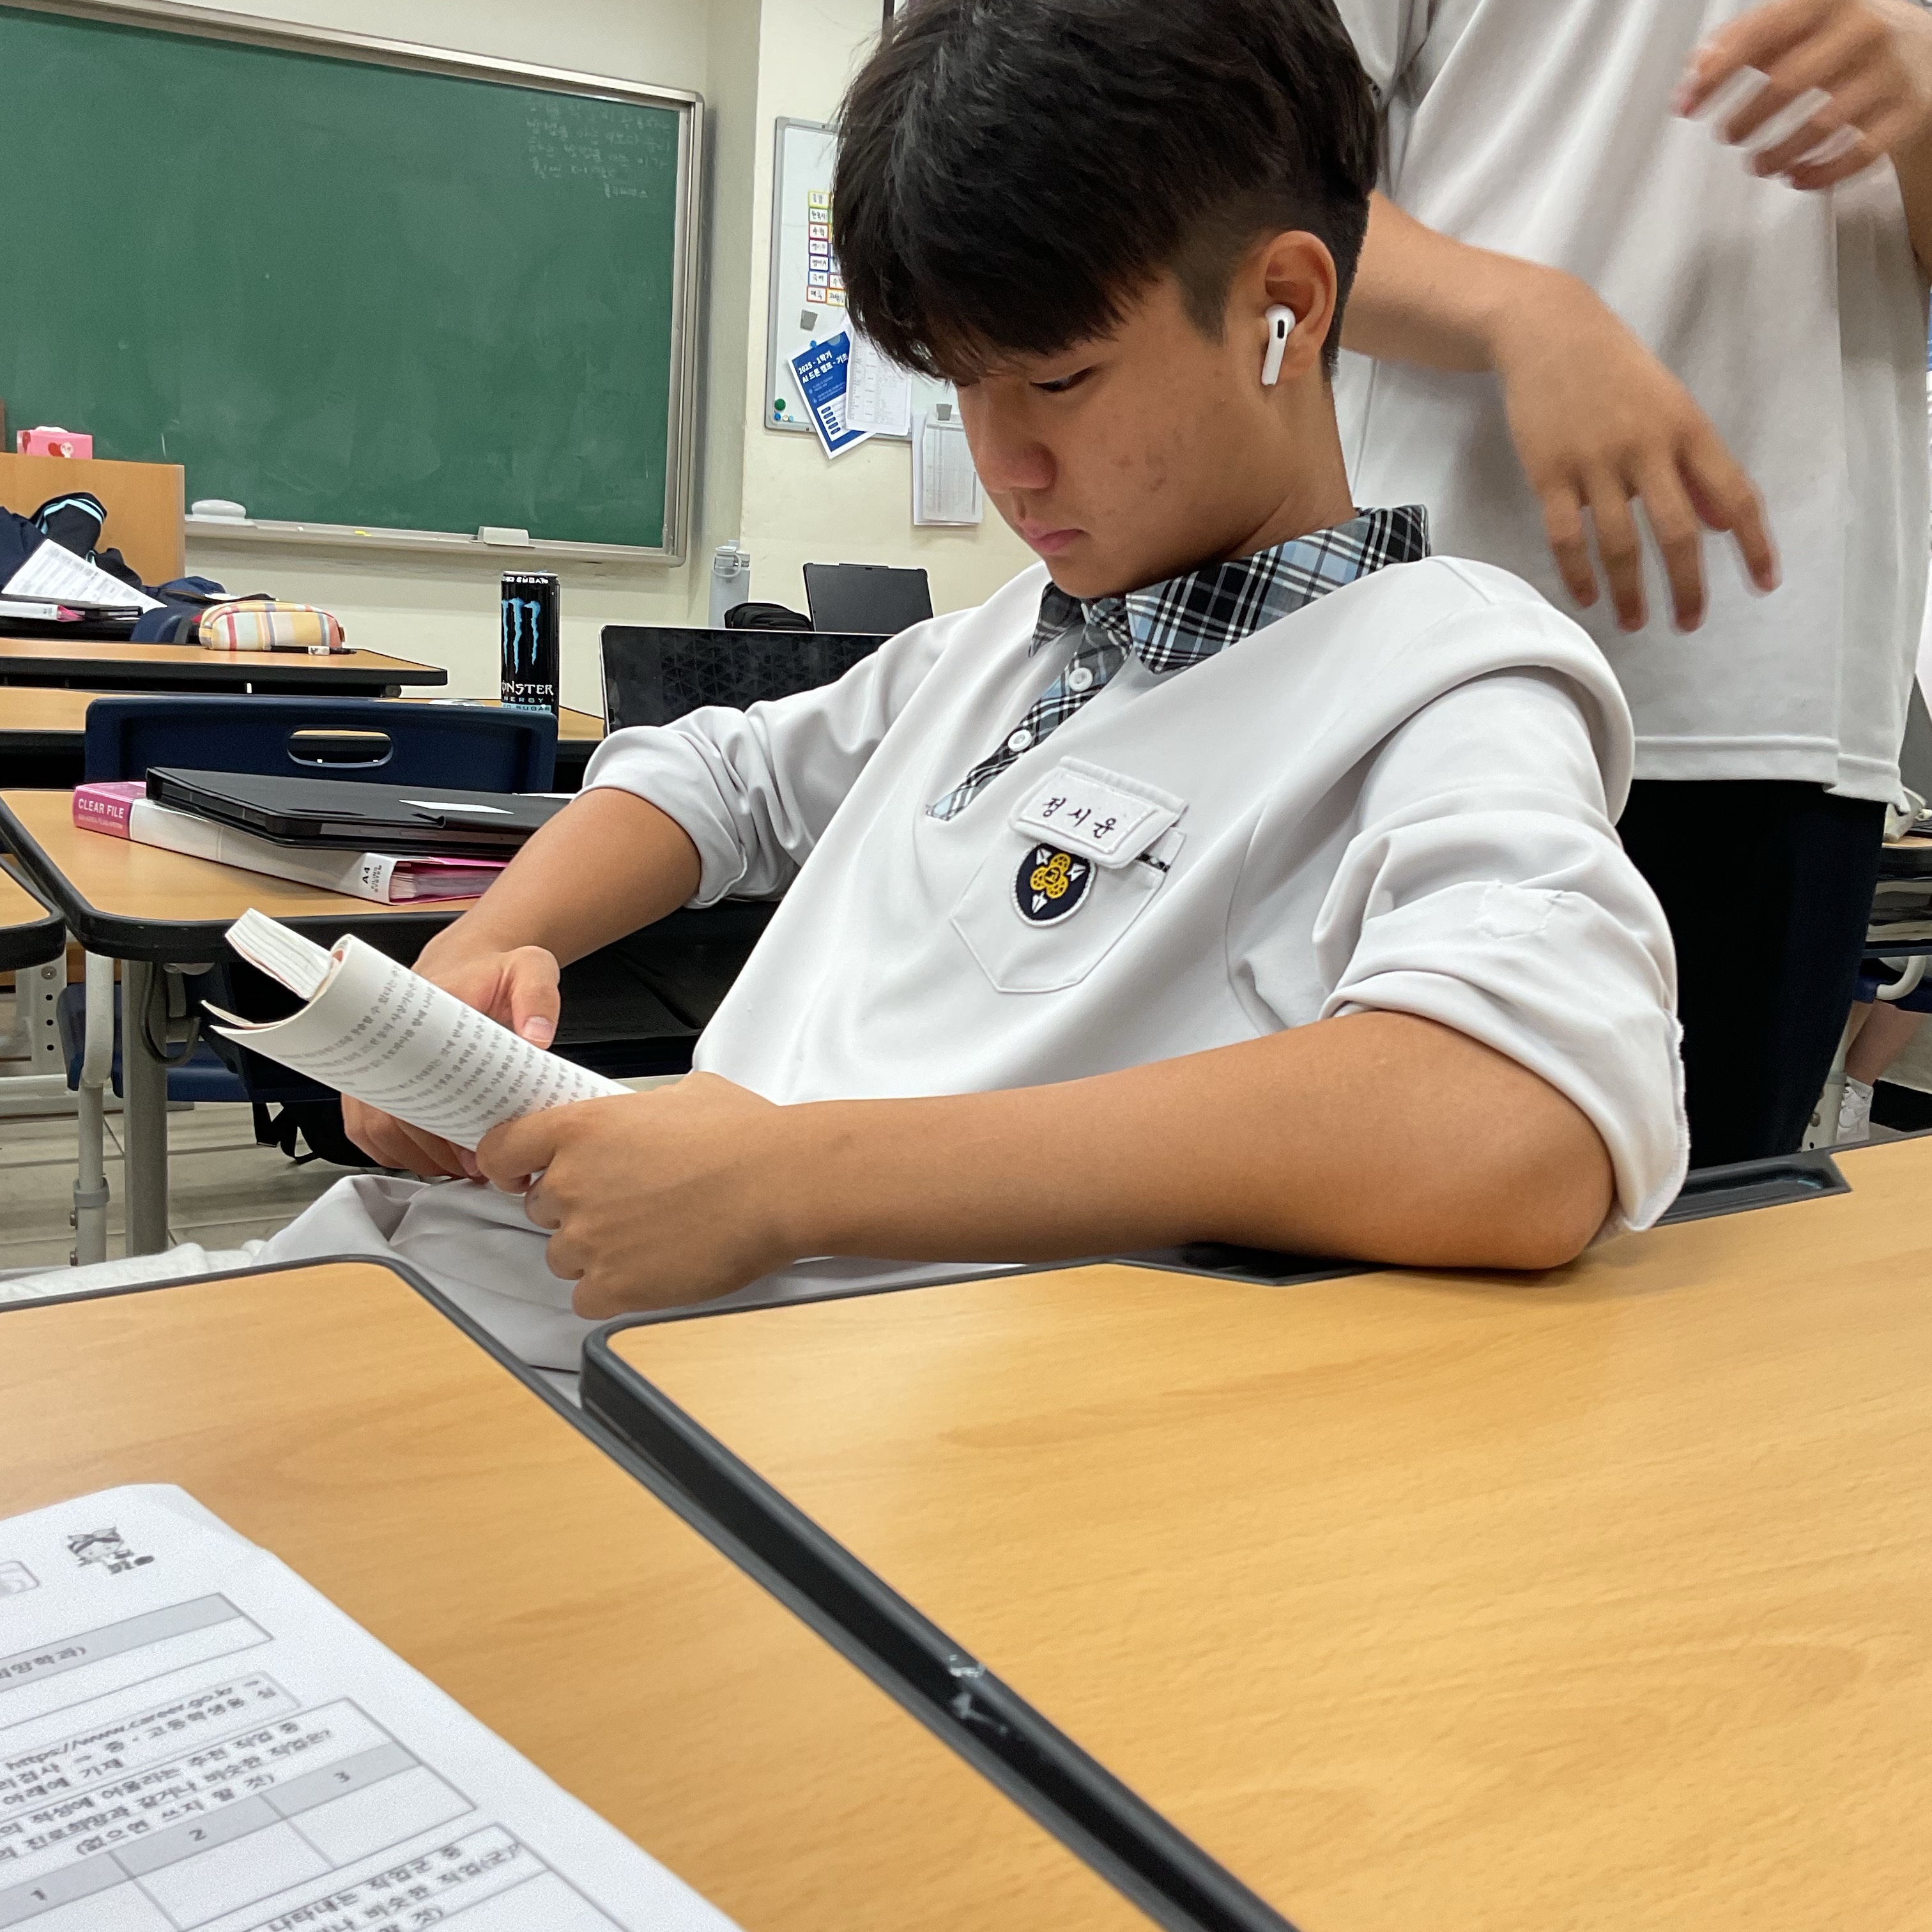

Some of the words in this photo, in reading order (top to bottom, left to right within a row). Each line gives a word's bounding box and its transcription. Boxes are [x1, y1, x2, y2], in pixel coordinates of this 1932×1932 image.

[811, 210, 827, 221] 한국사
[799, 361, 813, 375] 2025
[816, 349, 832, 364] 1학기
[802, 374, 809, 384] AI
[808, 367, 821, 380] 드론
[820, 362, 833, 373] 캠프
[502, 679, 554, 696] ONSTER
[78, 798, 105, 814] CLEAR
[107, 804, 125, 818] FILE
[362, 866, 371, 884] A4
[190, 1748, 227, 1767] 추천
[233, 1730, 273, 1749] 직업
[280, 1722, 298, 1734] 중
[3, 1777, 70, 1805] 아래에
[79, 1758, 124, 1778] 기재
[335, 1770, 351, 1784] 3
[25, 1806, 130, 1850] 진로희망과
[135, 1781, 197, 1810] 같거나
[76, 1820, 151, 1855] (없으면
[161, 1799, 204, 1822] 쓰지
[243, 1774, 274, 1790] 것)
[188, 1828, 206, 1842] 2
[33, 1889, 47, 1901] 1
[268, 1892, 358, 1932] 나타내는
[366, 1857, 433, 1890] 직업군
[441, 1846, 461, 1860] 중
